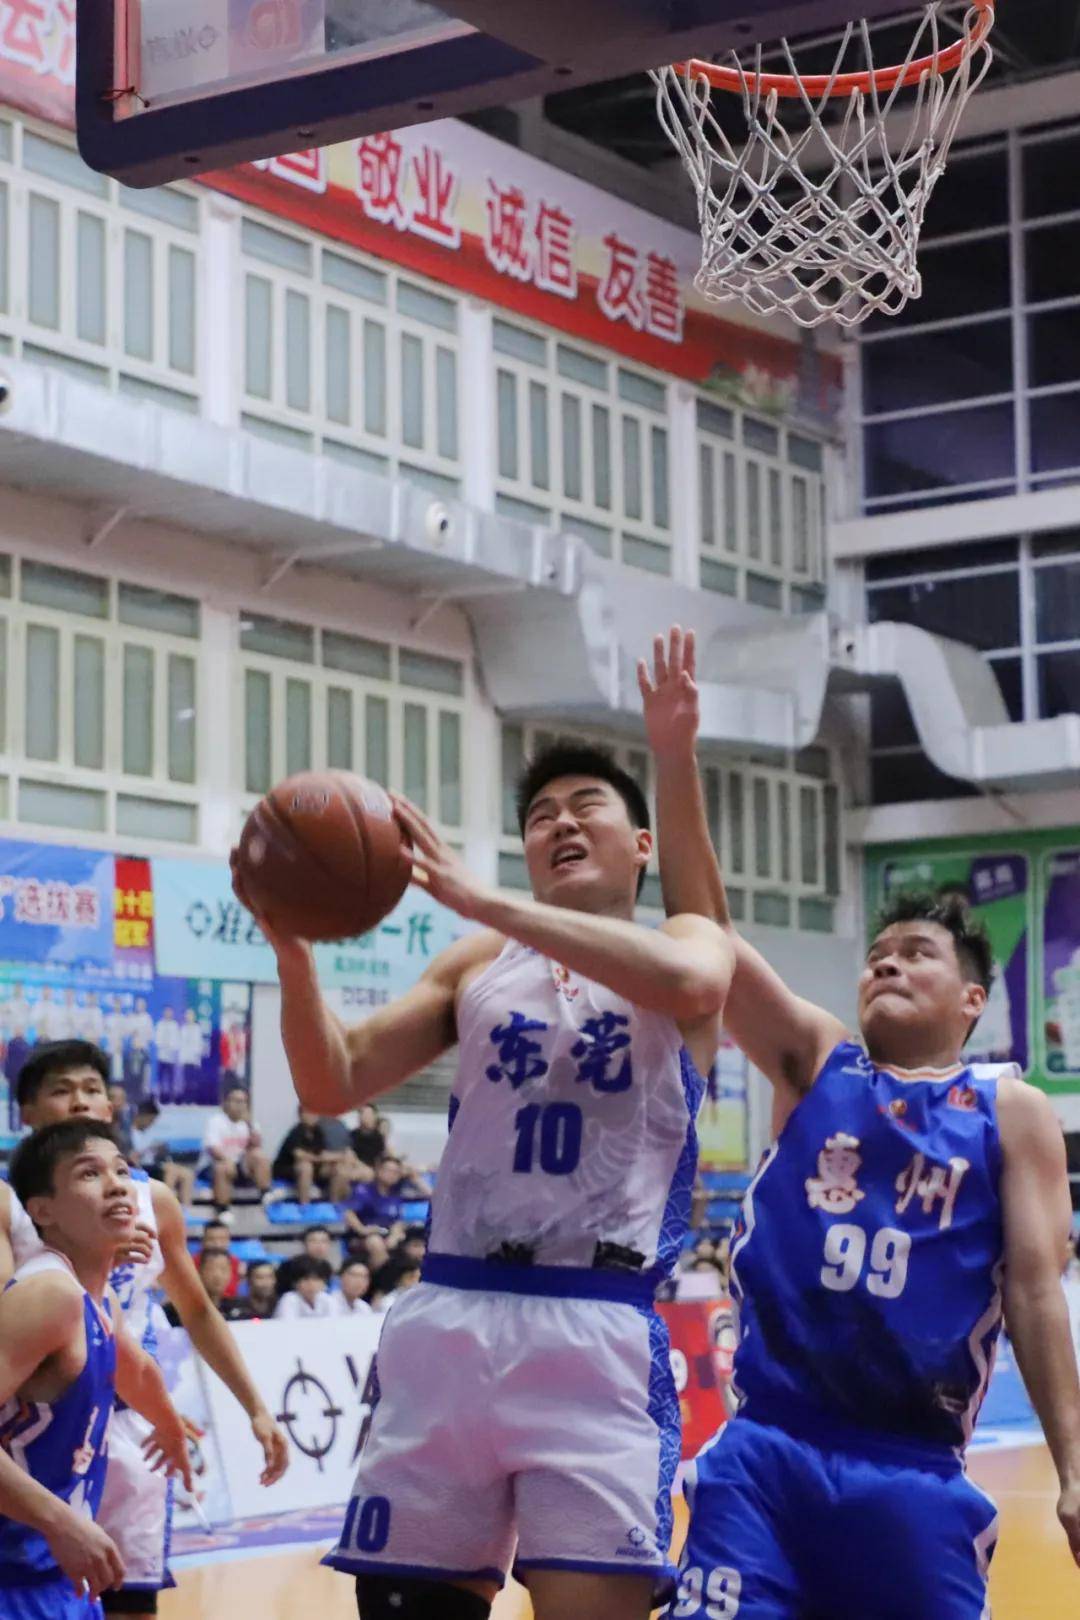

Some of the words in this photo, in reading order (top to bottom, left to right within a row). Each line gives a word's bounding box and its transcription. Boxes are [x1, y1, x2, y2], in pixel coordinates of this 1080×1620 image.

[356, 131, 458, 243] 敬业
[485, 176, 575, 292] 诚信
[601, 230, 682, 337] 友善
[0, 877, 97, 926] 选拔赛
[485, 1010, 633, 1094] 东莞
[512, 1102, 583, 1175] 10
[820, 1223, 912, 1299] 99
[339, 1495, 391, 1553] 10
[672, 1566, 742, 1620] 99
